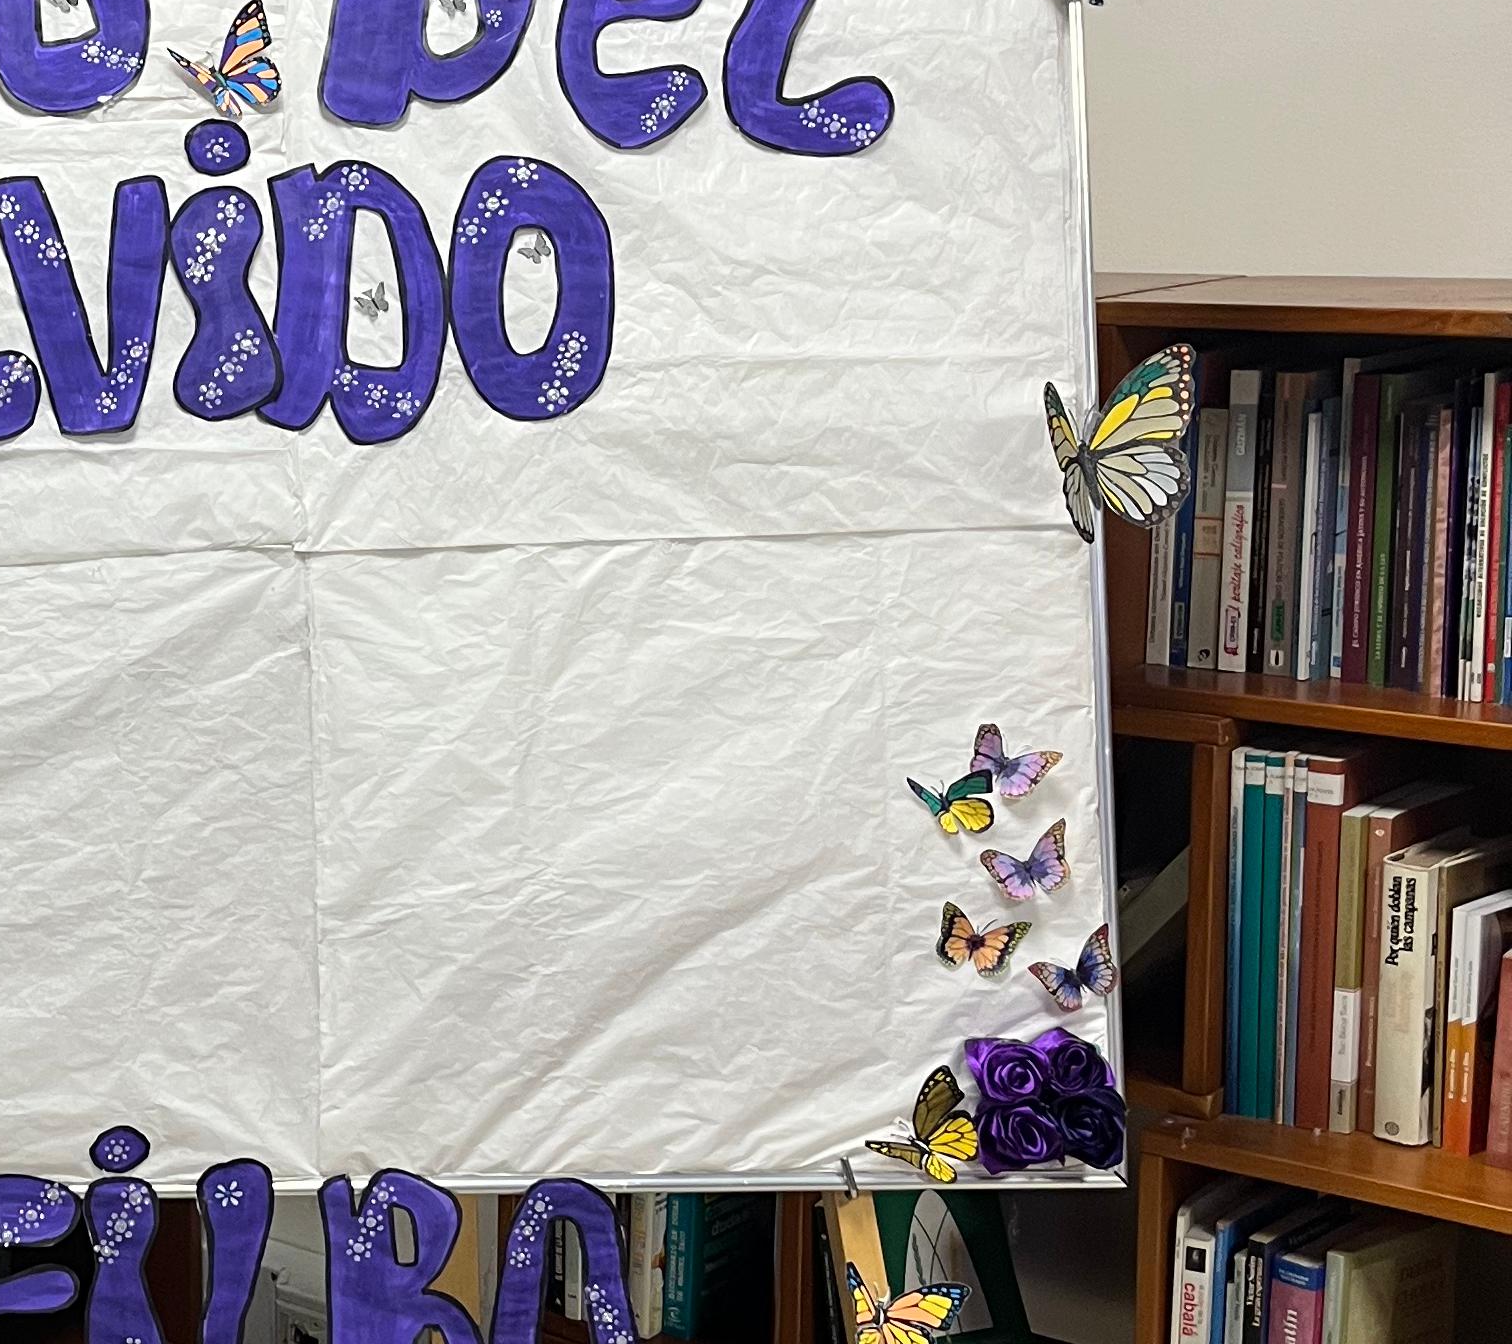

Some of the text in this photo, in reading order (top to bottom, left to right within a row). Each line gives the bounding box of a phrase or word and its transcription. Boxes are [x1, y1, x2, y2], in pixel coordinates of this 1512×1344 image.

[1385, 875, 1402, 965] Por quién doblan
[1402, 877, 1416, 952] las campanas
[1182, 1283, 1198, 1336] cabalá
